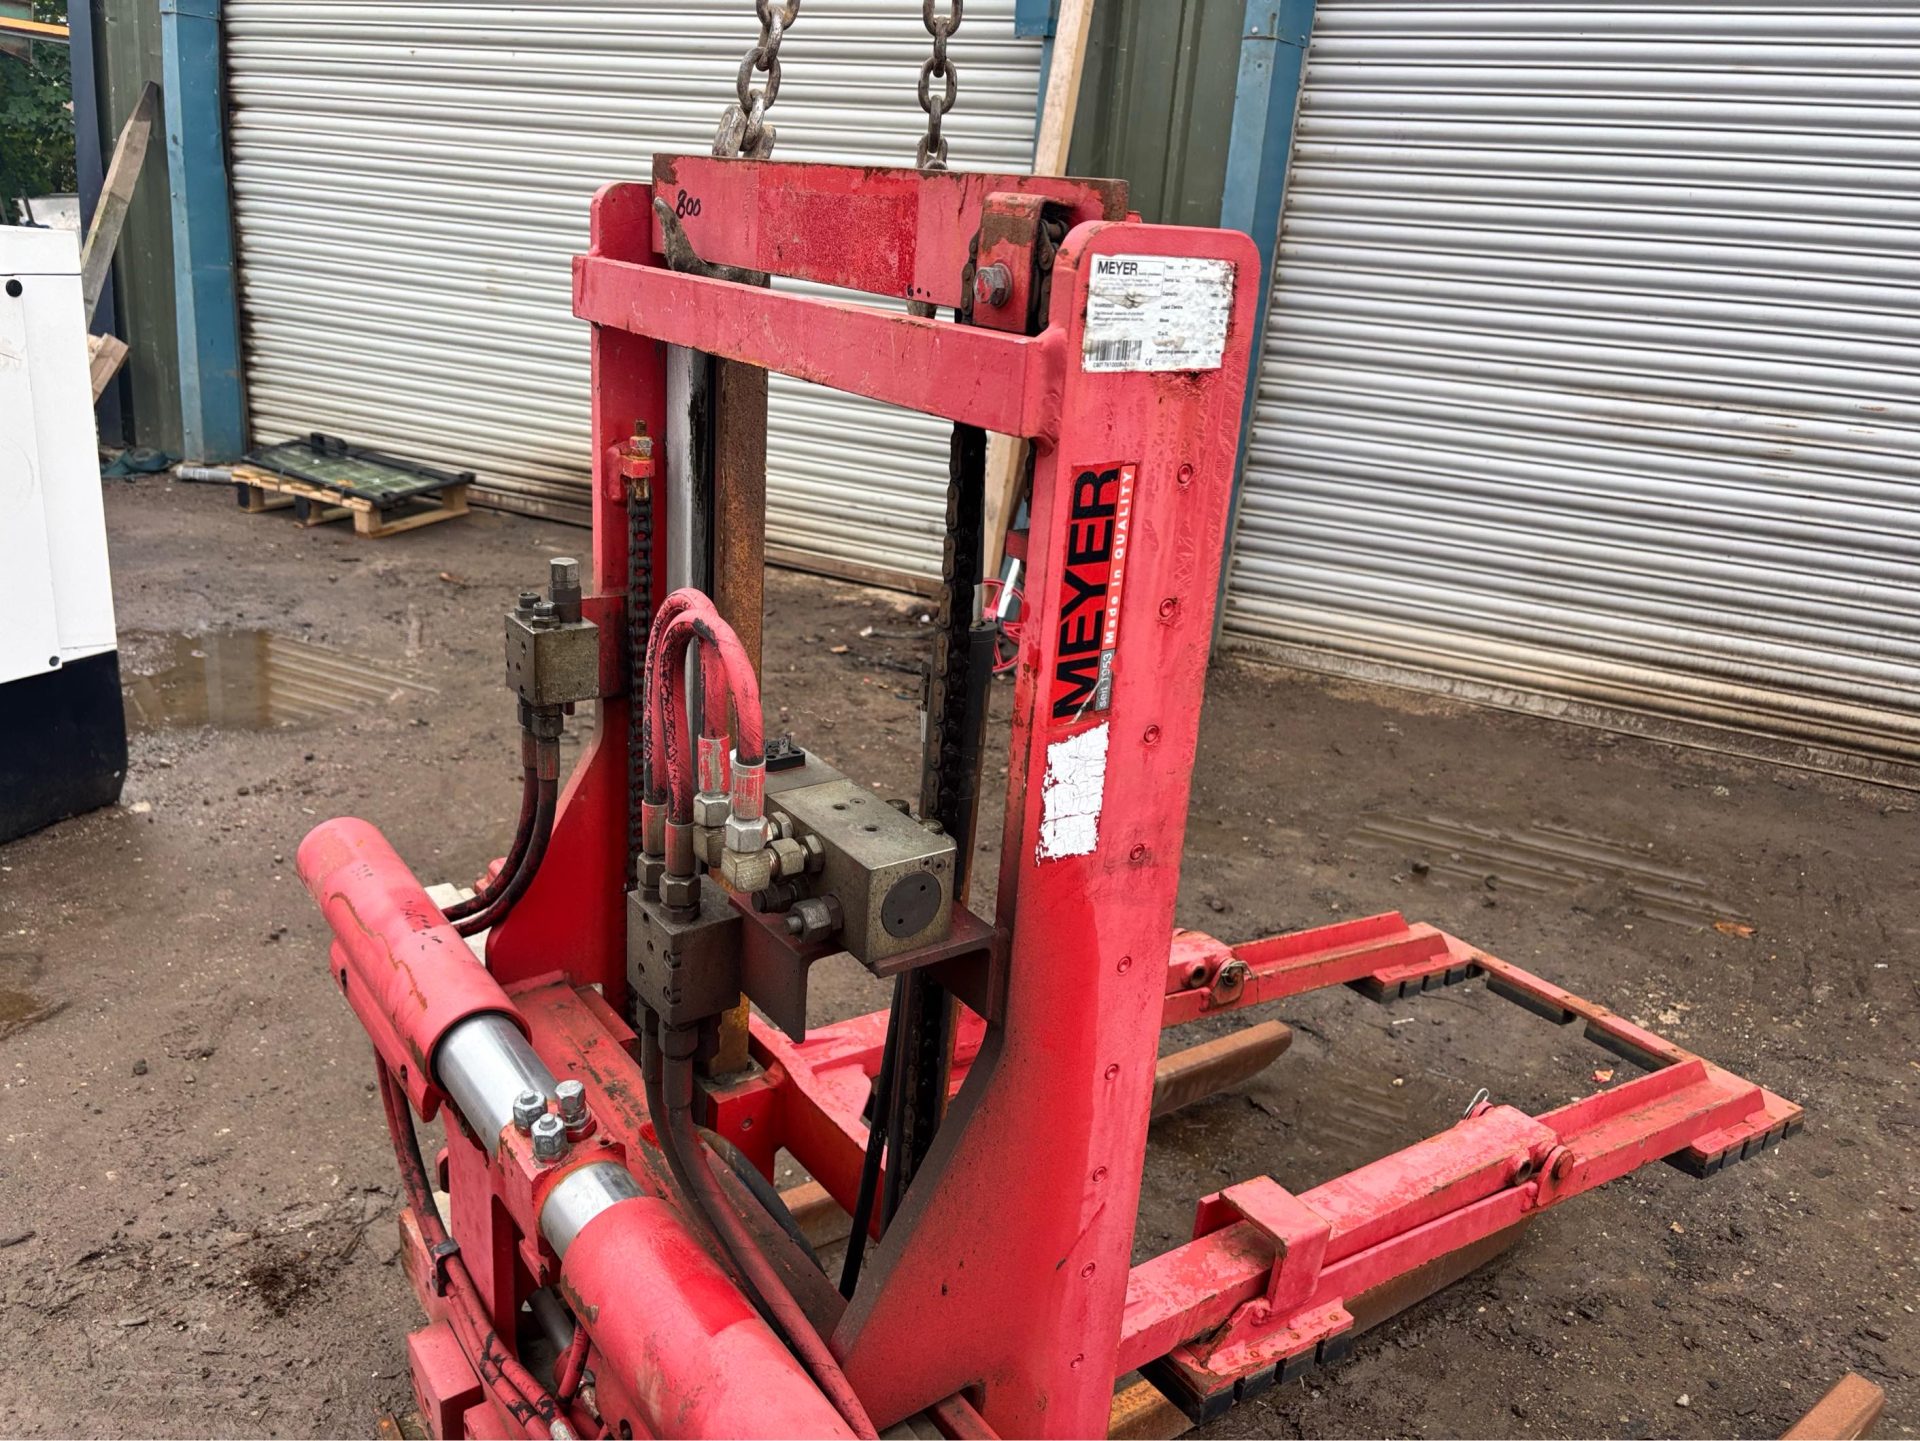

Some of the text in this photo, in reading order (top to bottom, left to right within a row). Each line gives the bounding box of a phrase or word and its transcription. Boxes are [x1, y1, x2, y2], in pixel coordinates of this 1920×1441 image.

[676, 189, 701, 219] 800
[1097, 260, 1138, 276] MEYER
[1053, 468, 1119, 719] MEYER
[1105, 472, 1133, 644] Made in QUALITY
